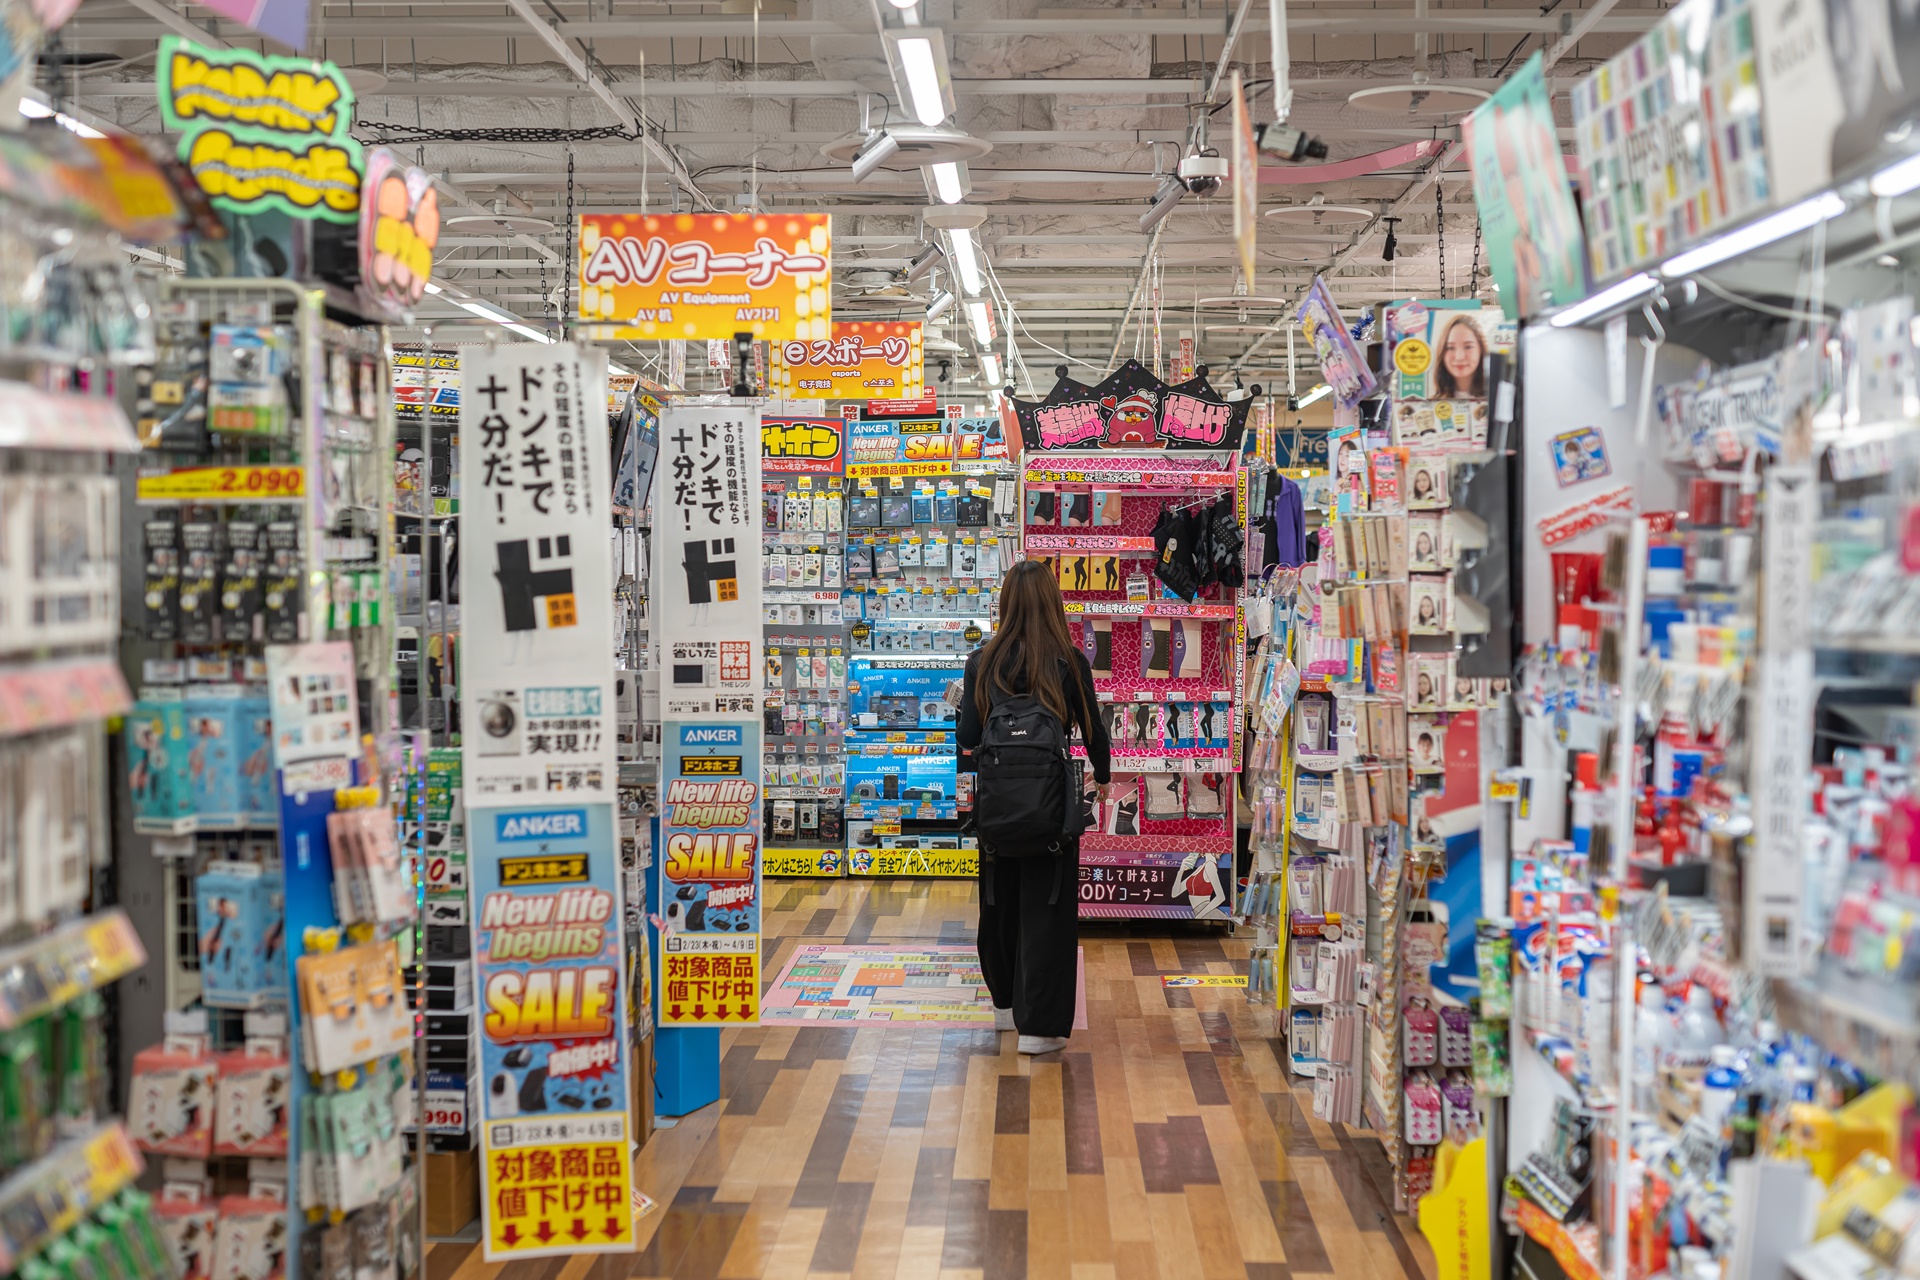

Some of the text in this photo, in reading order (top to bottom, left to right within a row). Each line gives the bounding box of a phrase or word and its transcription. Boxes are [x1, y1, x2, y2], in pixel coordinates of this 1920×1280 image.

[659, 292, 752, 306] AV Equipment
[798, 380, 833, 389] 电子竞技
[831, 370, 861, 378] esports
[852, 424, 889, 434] ANKER
[517, 366, 555, 515] ドンキで
[851, 436, 900, 450] New life
[904, 434, 982, 460] SALE
[854, 448, 896, 462] begins
[671, 428, 697, 531] 十分だ!
[699, 423, 725, 525] ドンキで
[723, 422, 740, 525] その程度の機能なら
[860, 464, 938, 476] 対象商品値下げ中
[815, 592, 839, 600] 6,980
[672, 648, 718, 659] 省いた
[722, 642, 749, 652] あたため
[722, 652, 748, 668] 解凍
[684, 730, 737, 742] ANKER
[892, 746, 920, 754] SALE
[914, 756, 950, 764] ANKER
[1115, 758, 1147, 768] ¥4,527
[666, 780, 757, 804] New life
[501, 815, 582, 839] ANKER
[670, 803, 750, 829] begins
[664, 832, 756, 883] SALE
[1092, 868, 1164, 882] 楽して叶える!
[706, 884, 756, 908] 開催中!
[480, 888, 612, 931] New life
[489, 924, 604, 962] begins
[667, 955, 754, 978] 対象商品
[667, 980, 754, 1002] 値下げ中
[484, 969, 615, 1043] SALE
[495, 1148, 621, 1183] 対象商品
[496, 1182, 622, 1220] 値下げ中
